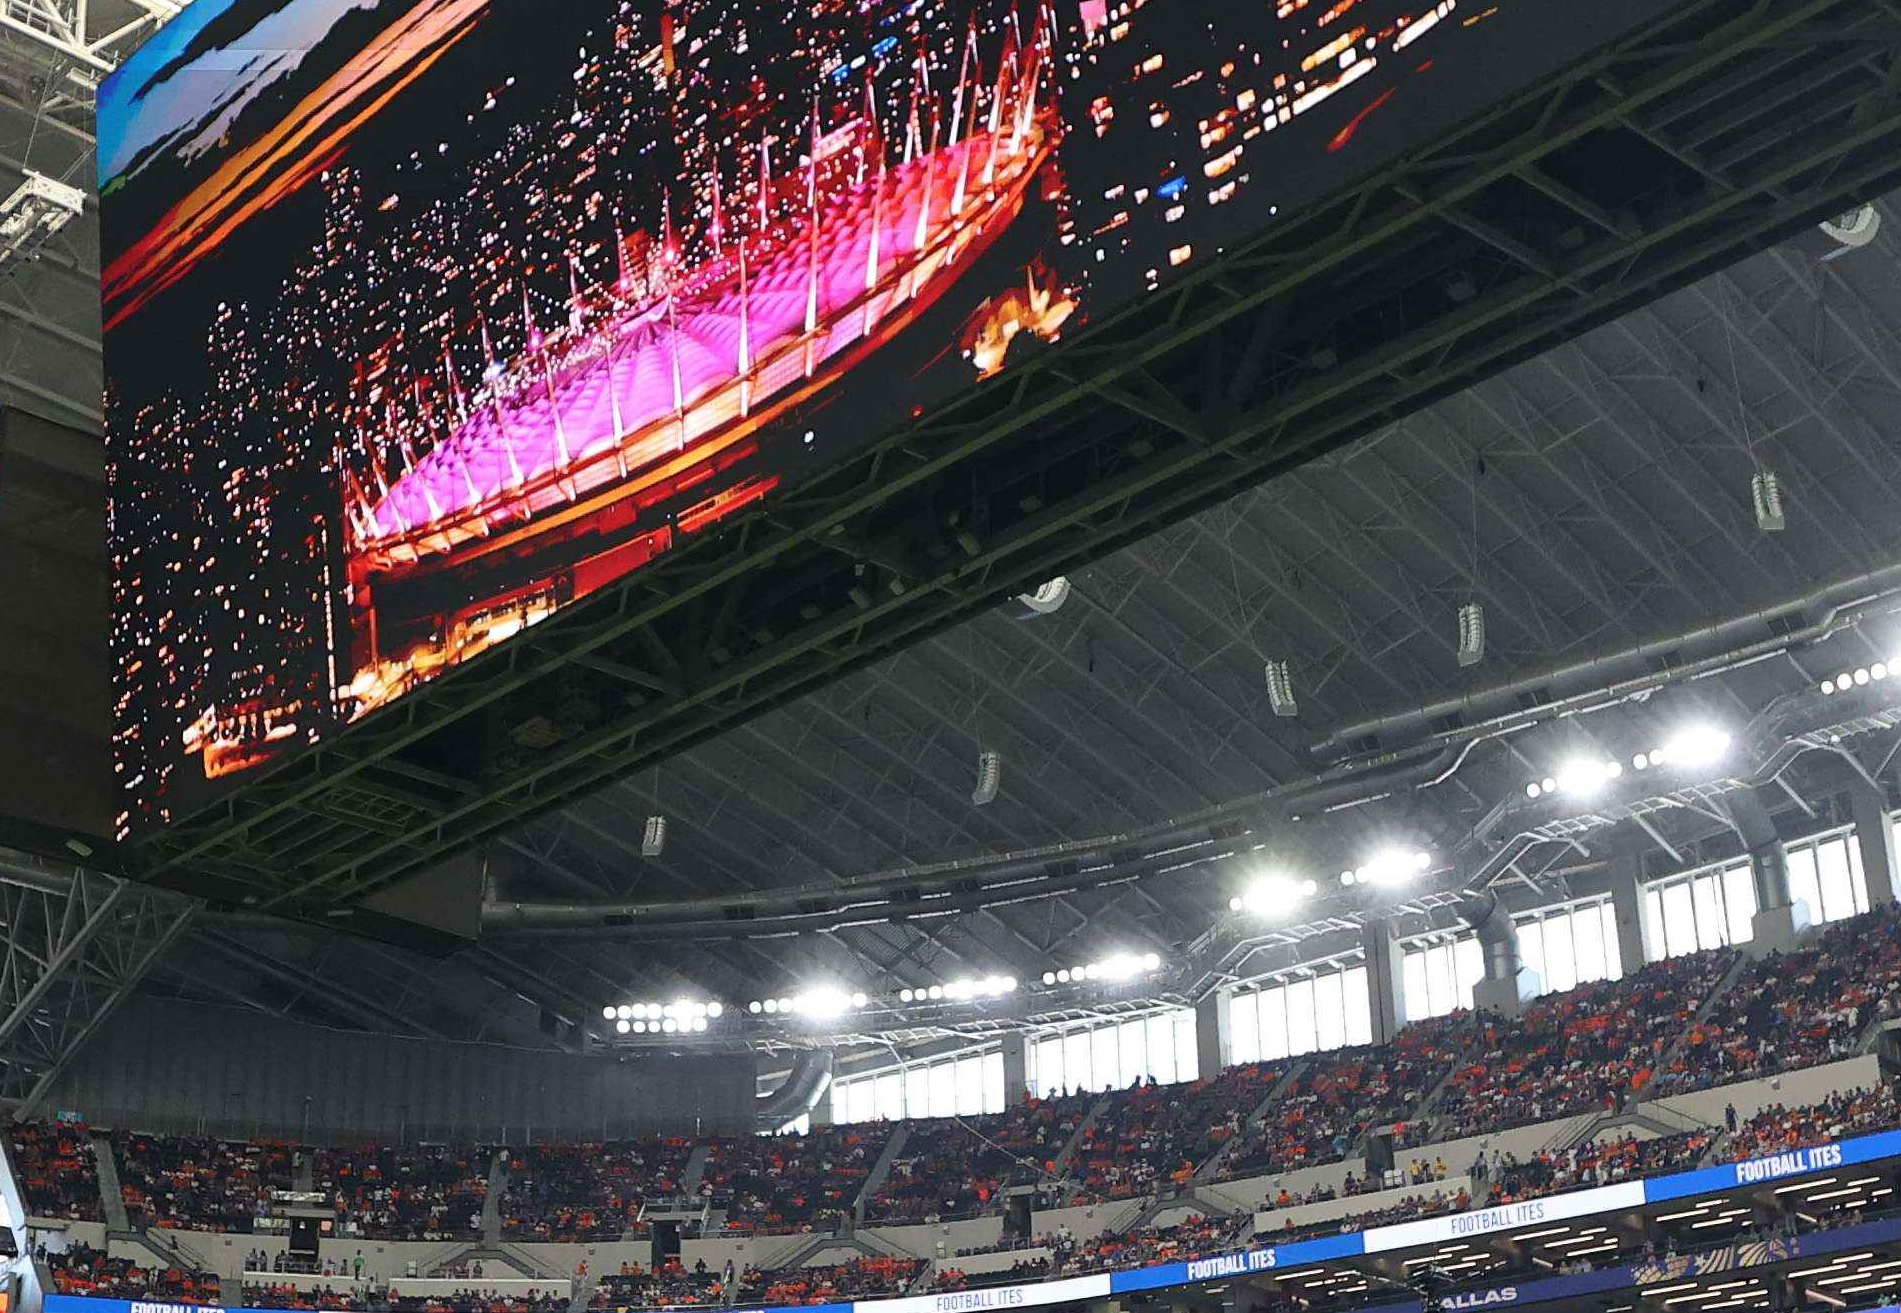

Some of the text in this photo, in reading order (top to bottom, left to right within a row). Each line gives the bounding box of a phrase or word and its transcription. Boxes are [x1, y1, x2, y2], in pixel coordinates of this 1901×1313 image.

[1736, 1156, 1806, 1184] FOOTBALL
[1451, 1211, 1512, 1235] FOOTBALL
[1187, 1256, 1246, 1280] FOOTBALL
[937, 1291, 991, 1311] FOOTBALL
[1427, 1286, 1518, 1312] ALLAS
